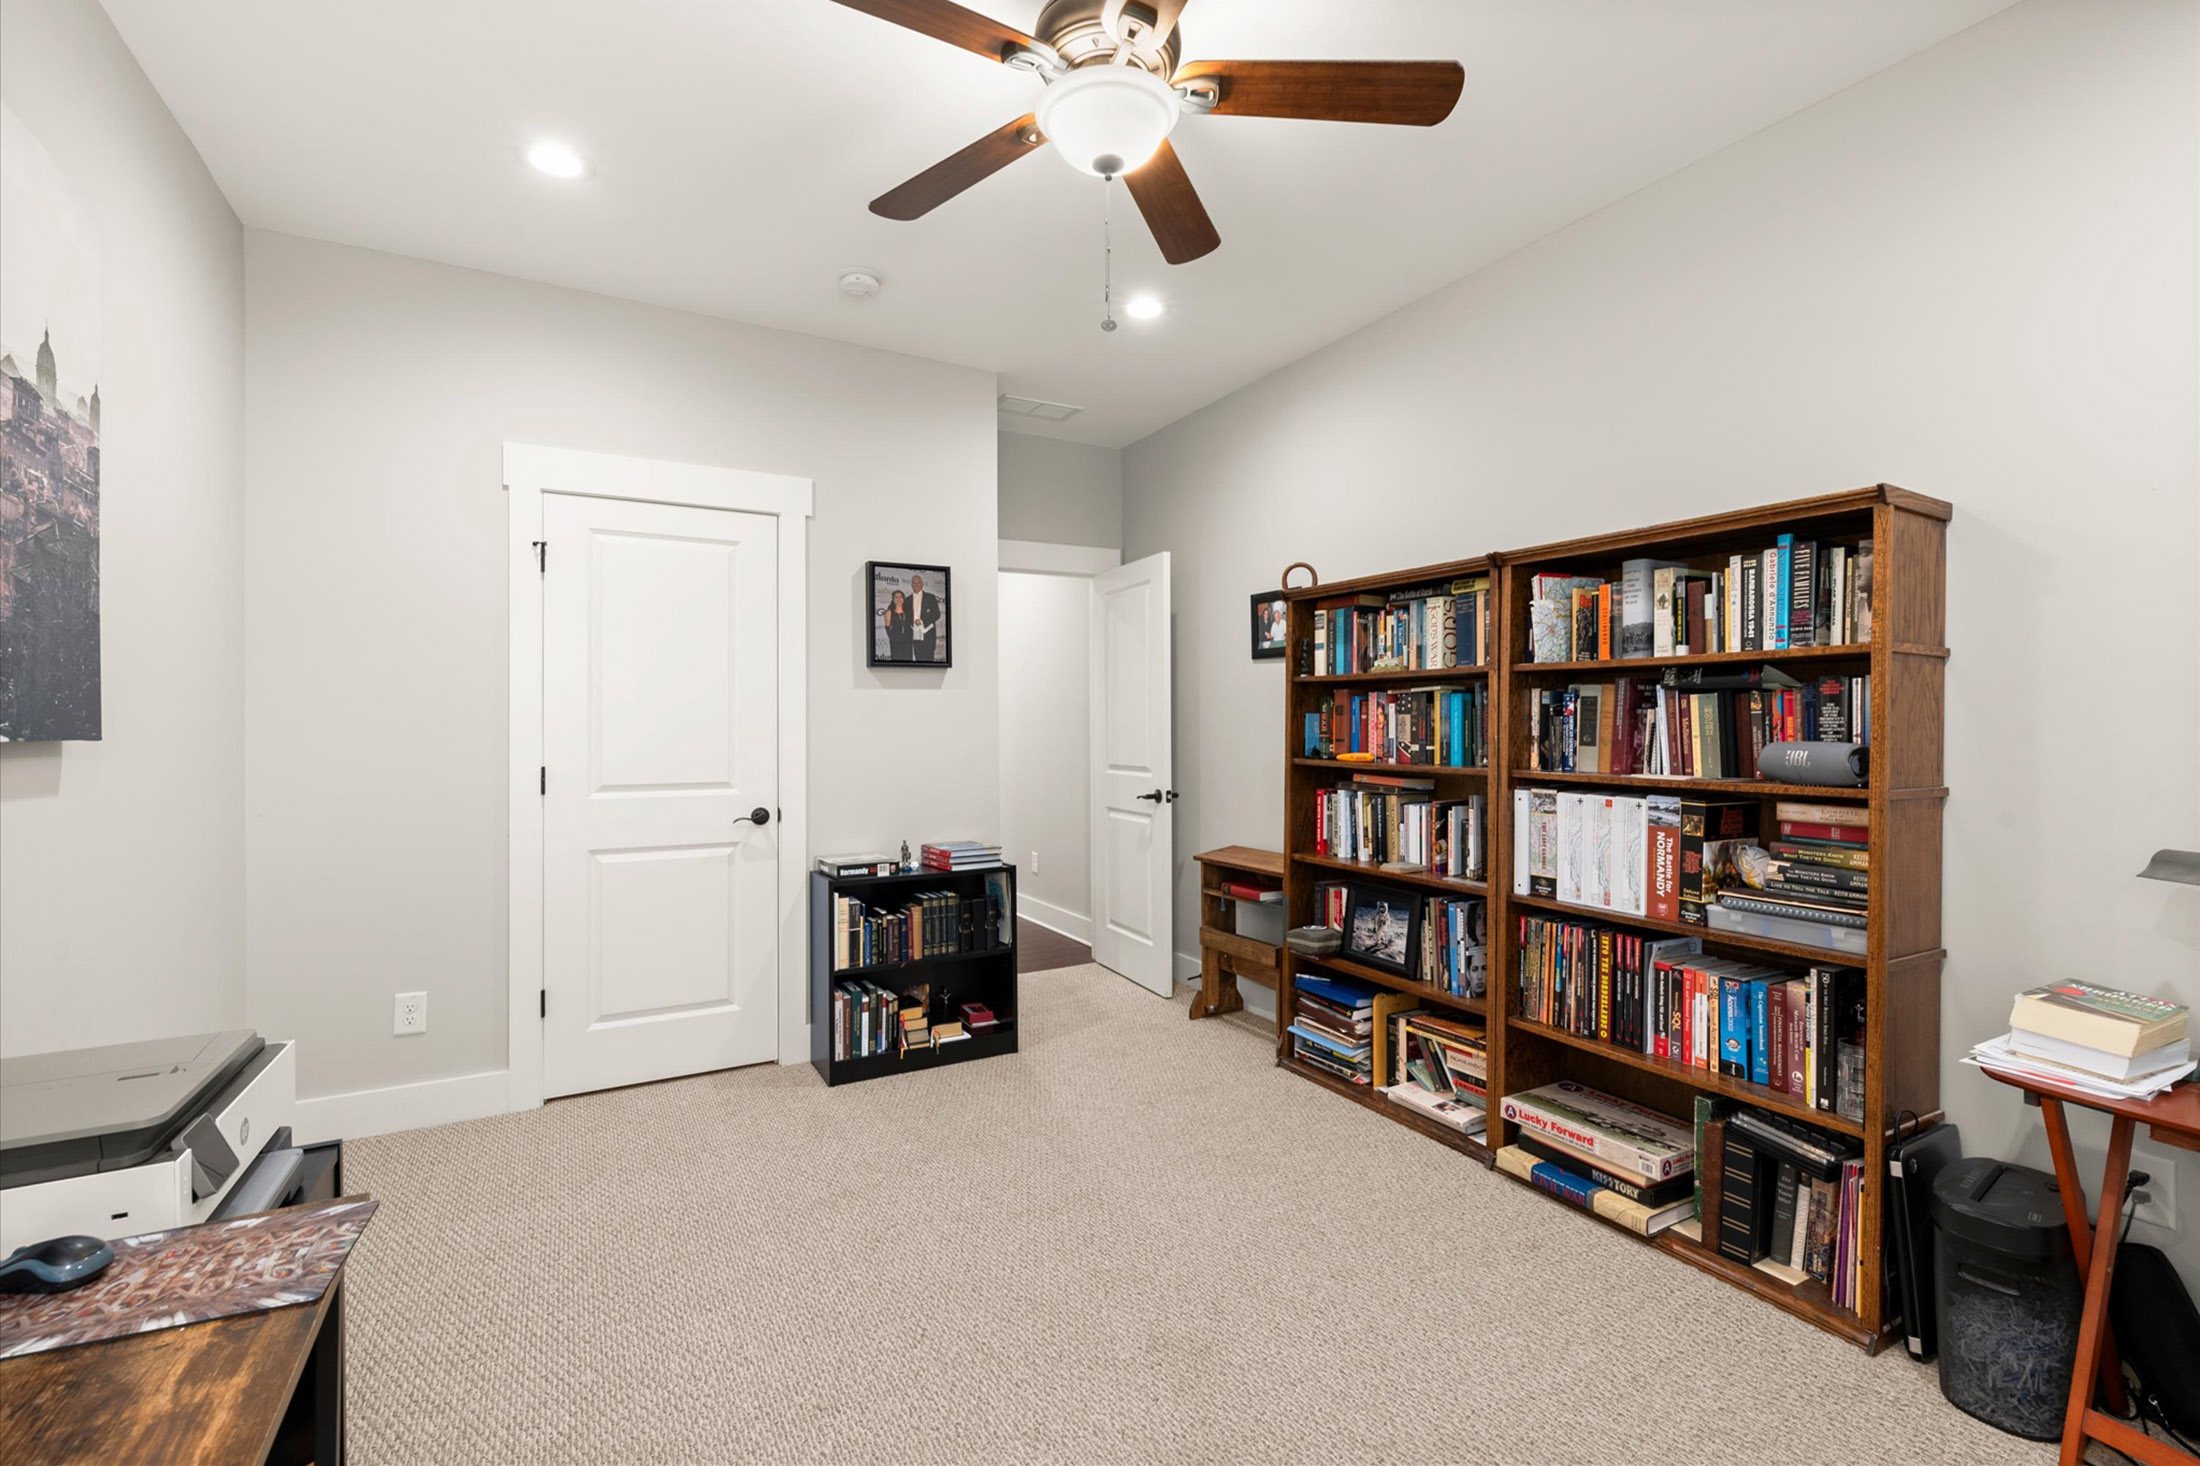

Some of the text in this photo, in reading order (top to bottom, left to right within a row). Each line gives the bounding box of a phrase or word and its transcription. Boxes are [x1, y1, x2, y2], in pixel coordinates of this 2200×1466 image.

[1794, 549, 1810, 569] FIVE
[1748, 568, 1756, 620] BARBAROSSA
[1768, 552, 1777, 641] Gabriele d'Annunzio
[1794, 570, 1810, 609] FAMILIES
[1748, 621, 1756, 638] 1941
[1430, 641, 1438, 667] WAR
[1785, 750, 1811, 767] JBL
[840, 867, 869, 876] Normandy
[1656, 831, 1666, 898] NORMANDY
[1600, 935, 1609, 1030] INTO THE BORDERLANDS
[1822, 972, 1830, 984] 150
[1710, 987, 1718, 1000] SQL
[2068, 983, 2173, 1011] SHRUGGED
[2115, 990, 2178, 1009] ATLAS
[1672, 1011, 1681, 1031] SQL
[1518, 1109, 1549, 1129] Lucky
[1550, 1121, 1594, 1147] Forward
[1531, 1172, 1561, 1196] CIVIL
[1562, 1187, 1586, 1206] WAR
